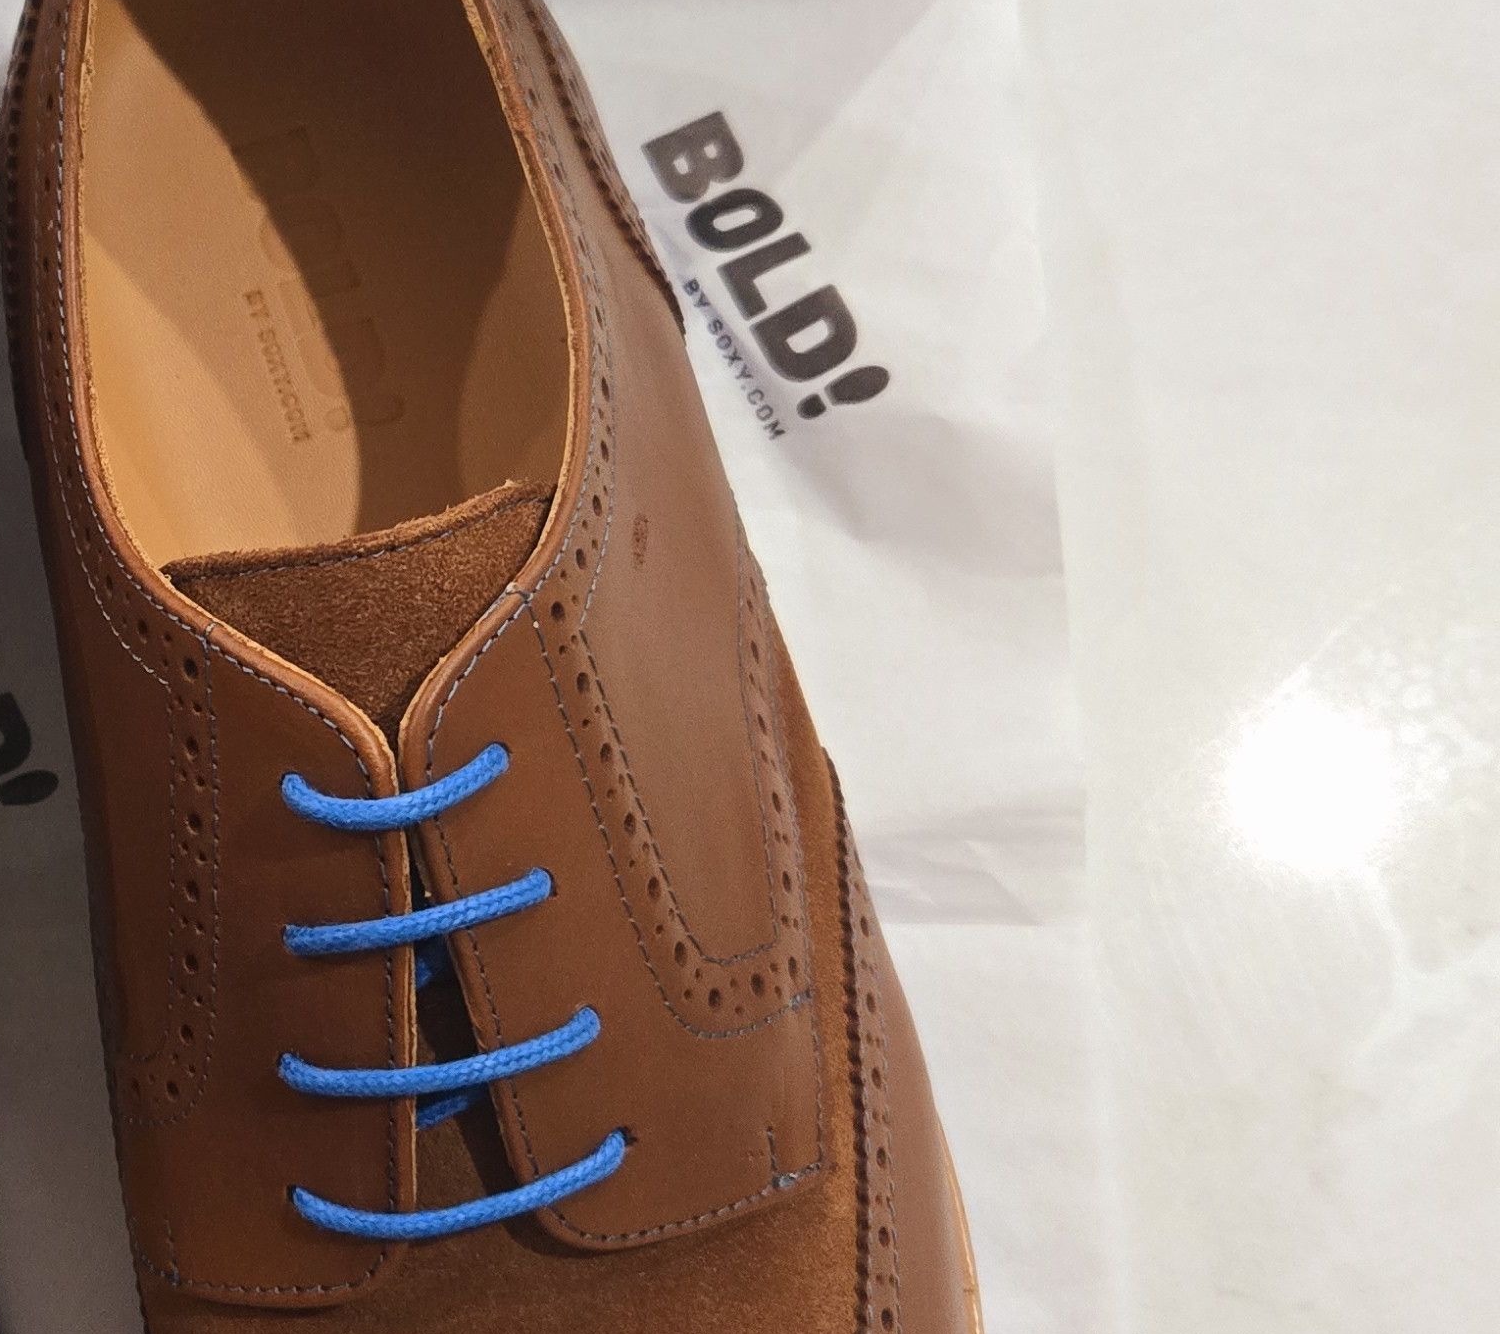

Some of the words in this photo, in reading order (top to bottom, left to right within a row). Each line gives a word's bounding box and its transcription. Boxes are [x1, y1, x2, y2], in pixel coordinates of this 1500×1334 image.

[641, 111, 890, 420] BOLD!
[683, 278, 712, 309] BY
[706, 319, 786, 441] SOXY.COM
